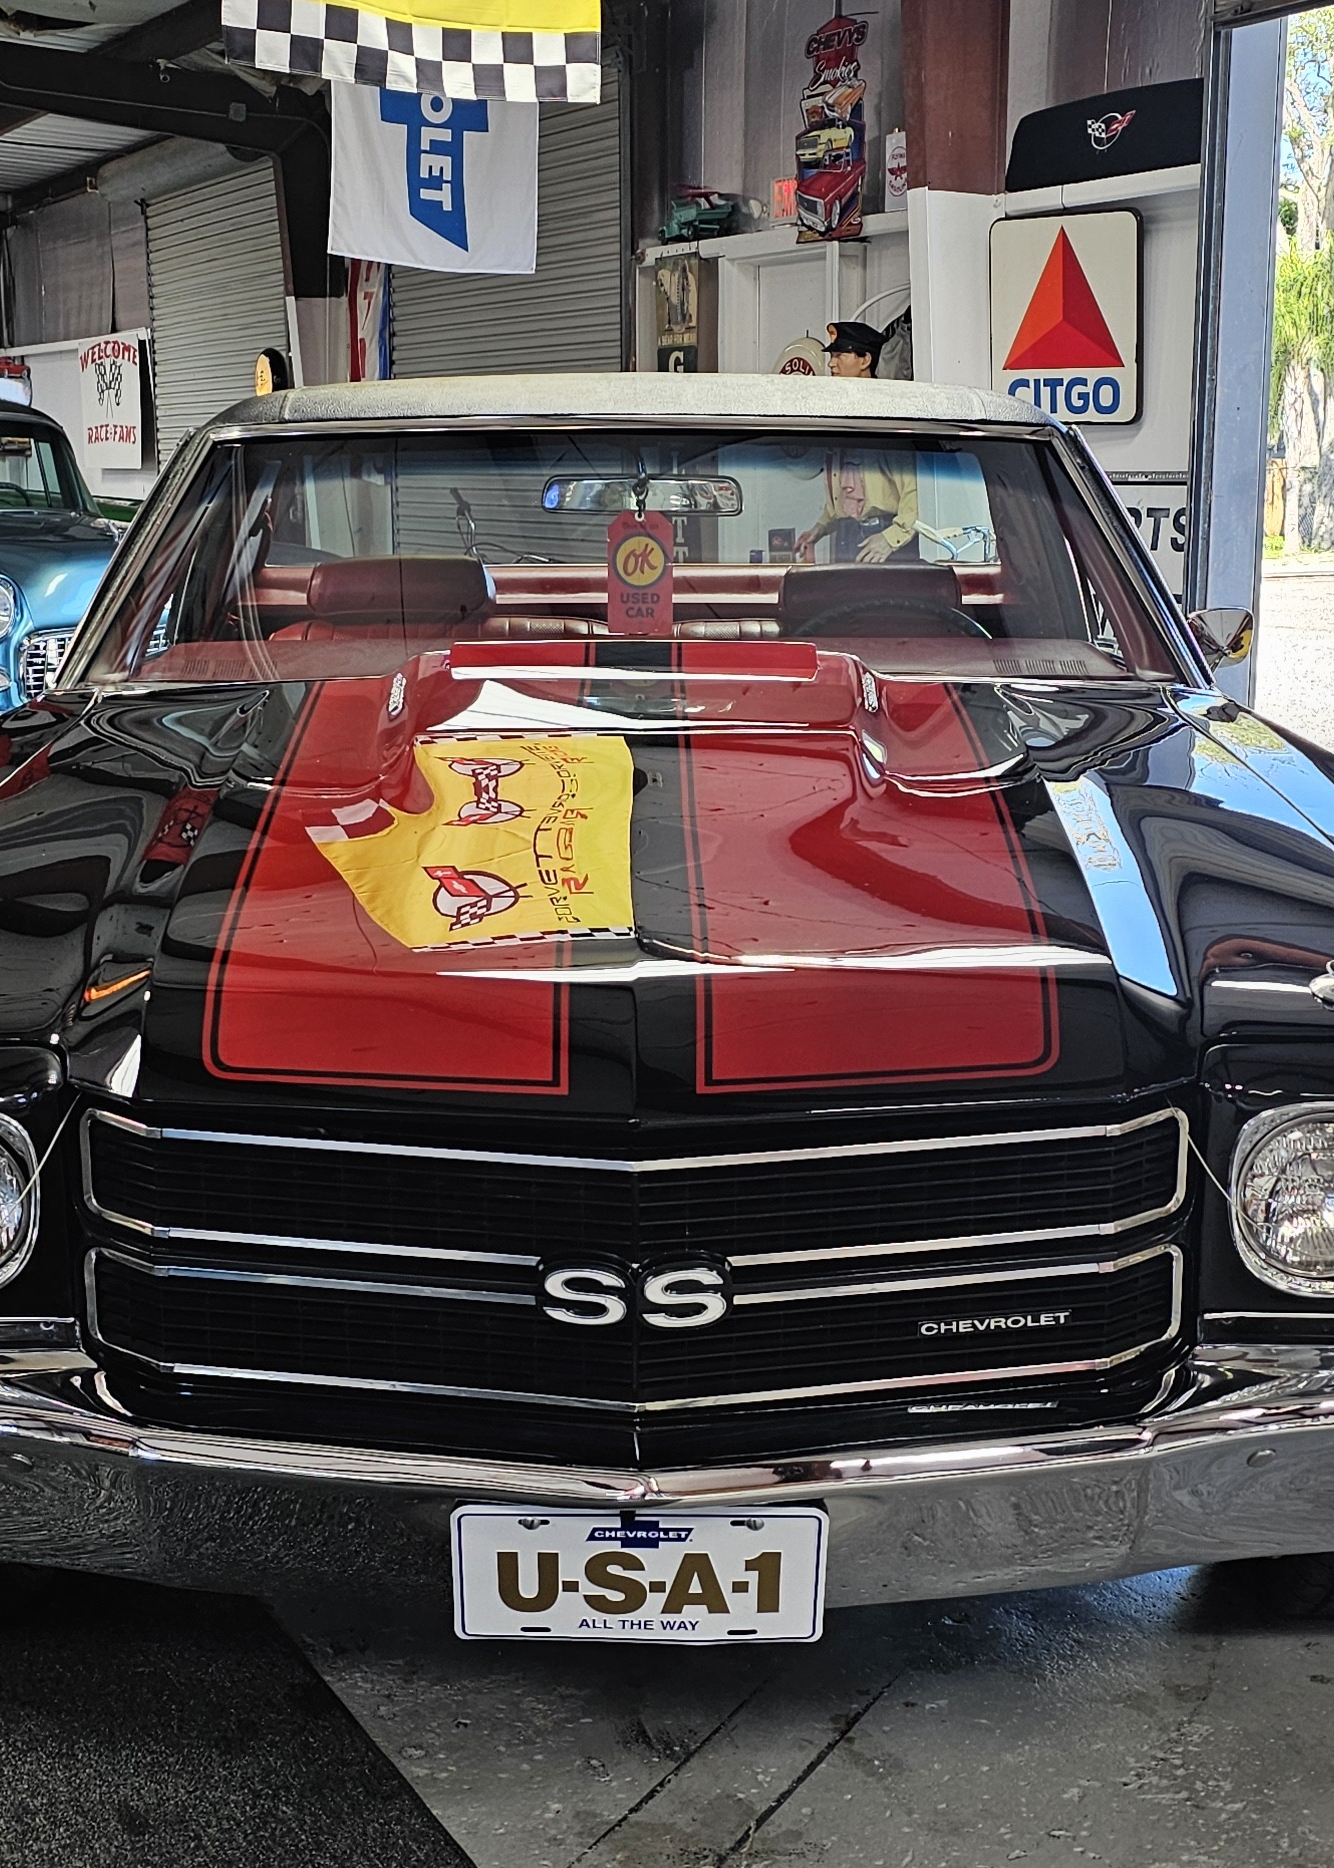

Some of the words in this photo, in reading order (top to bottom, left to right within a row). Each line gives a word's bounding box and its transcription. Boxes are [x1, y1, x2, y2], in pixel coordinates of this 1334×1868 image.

[419, 93, 453, 211] OLET
[80, 340, 138, 373] WELCOME
[1007, 376, 1120, 415] CITGO
[87, 424, 110, 444] RACE
[113, 424, 136, 444] FANS
[622, 543, 658, 577] OK
[620, 593, 660, 604] USED
[625, 607, 655, 618] CAR
[542, 1268, 727, 1328] SS
[920, 1312, 1070, 1335] CHEVROLET
[594, 1529, 689, 1540] CHEVROLET
[496, 1551, 782, 1614] U-S-A-1
[578, 1618, 615, 1630] ALL
[618, 1619, 654, 1630] THE
[660, 1620, 700, 1631] WAY
